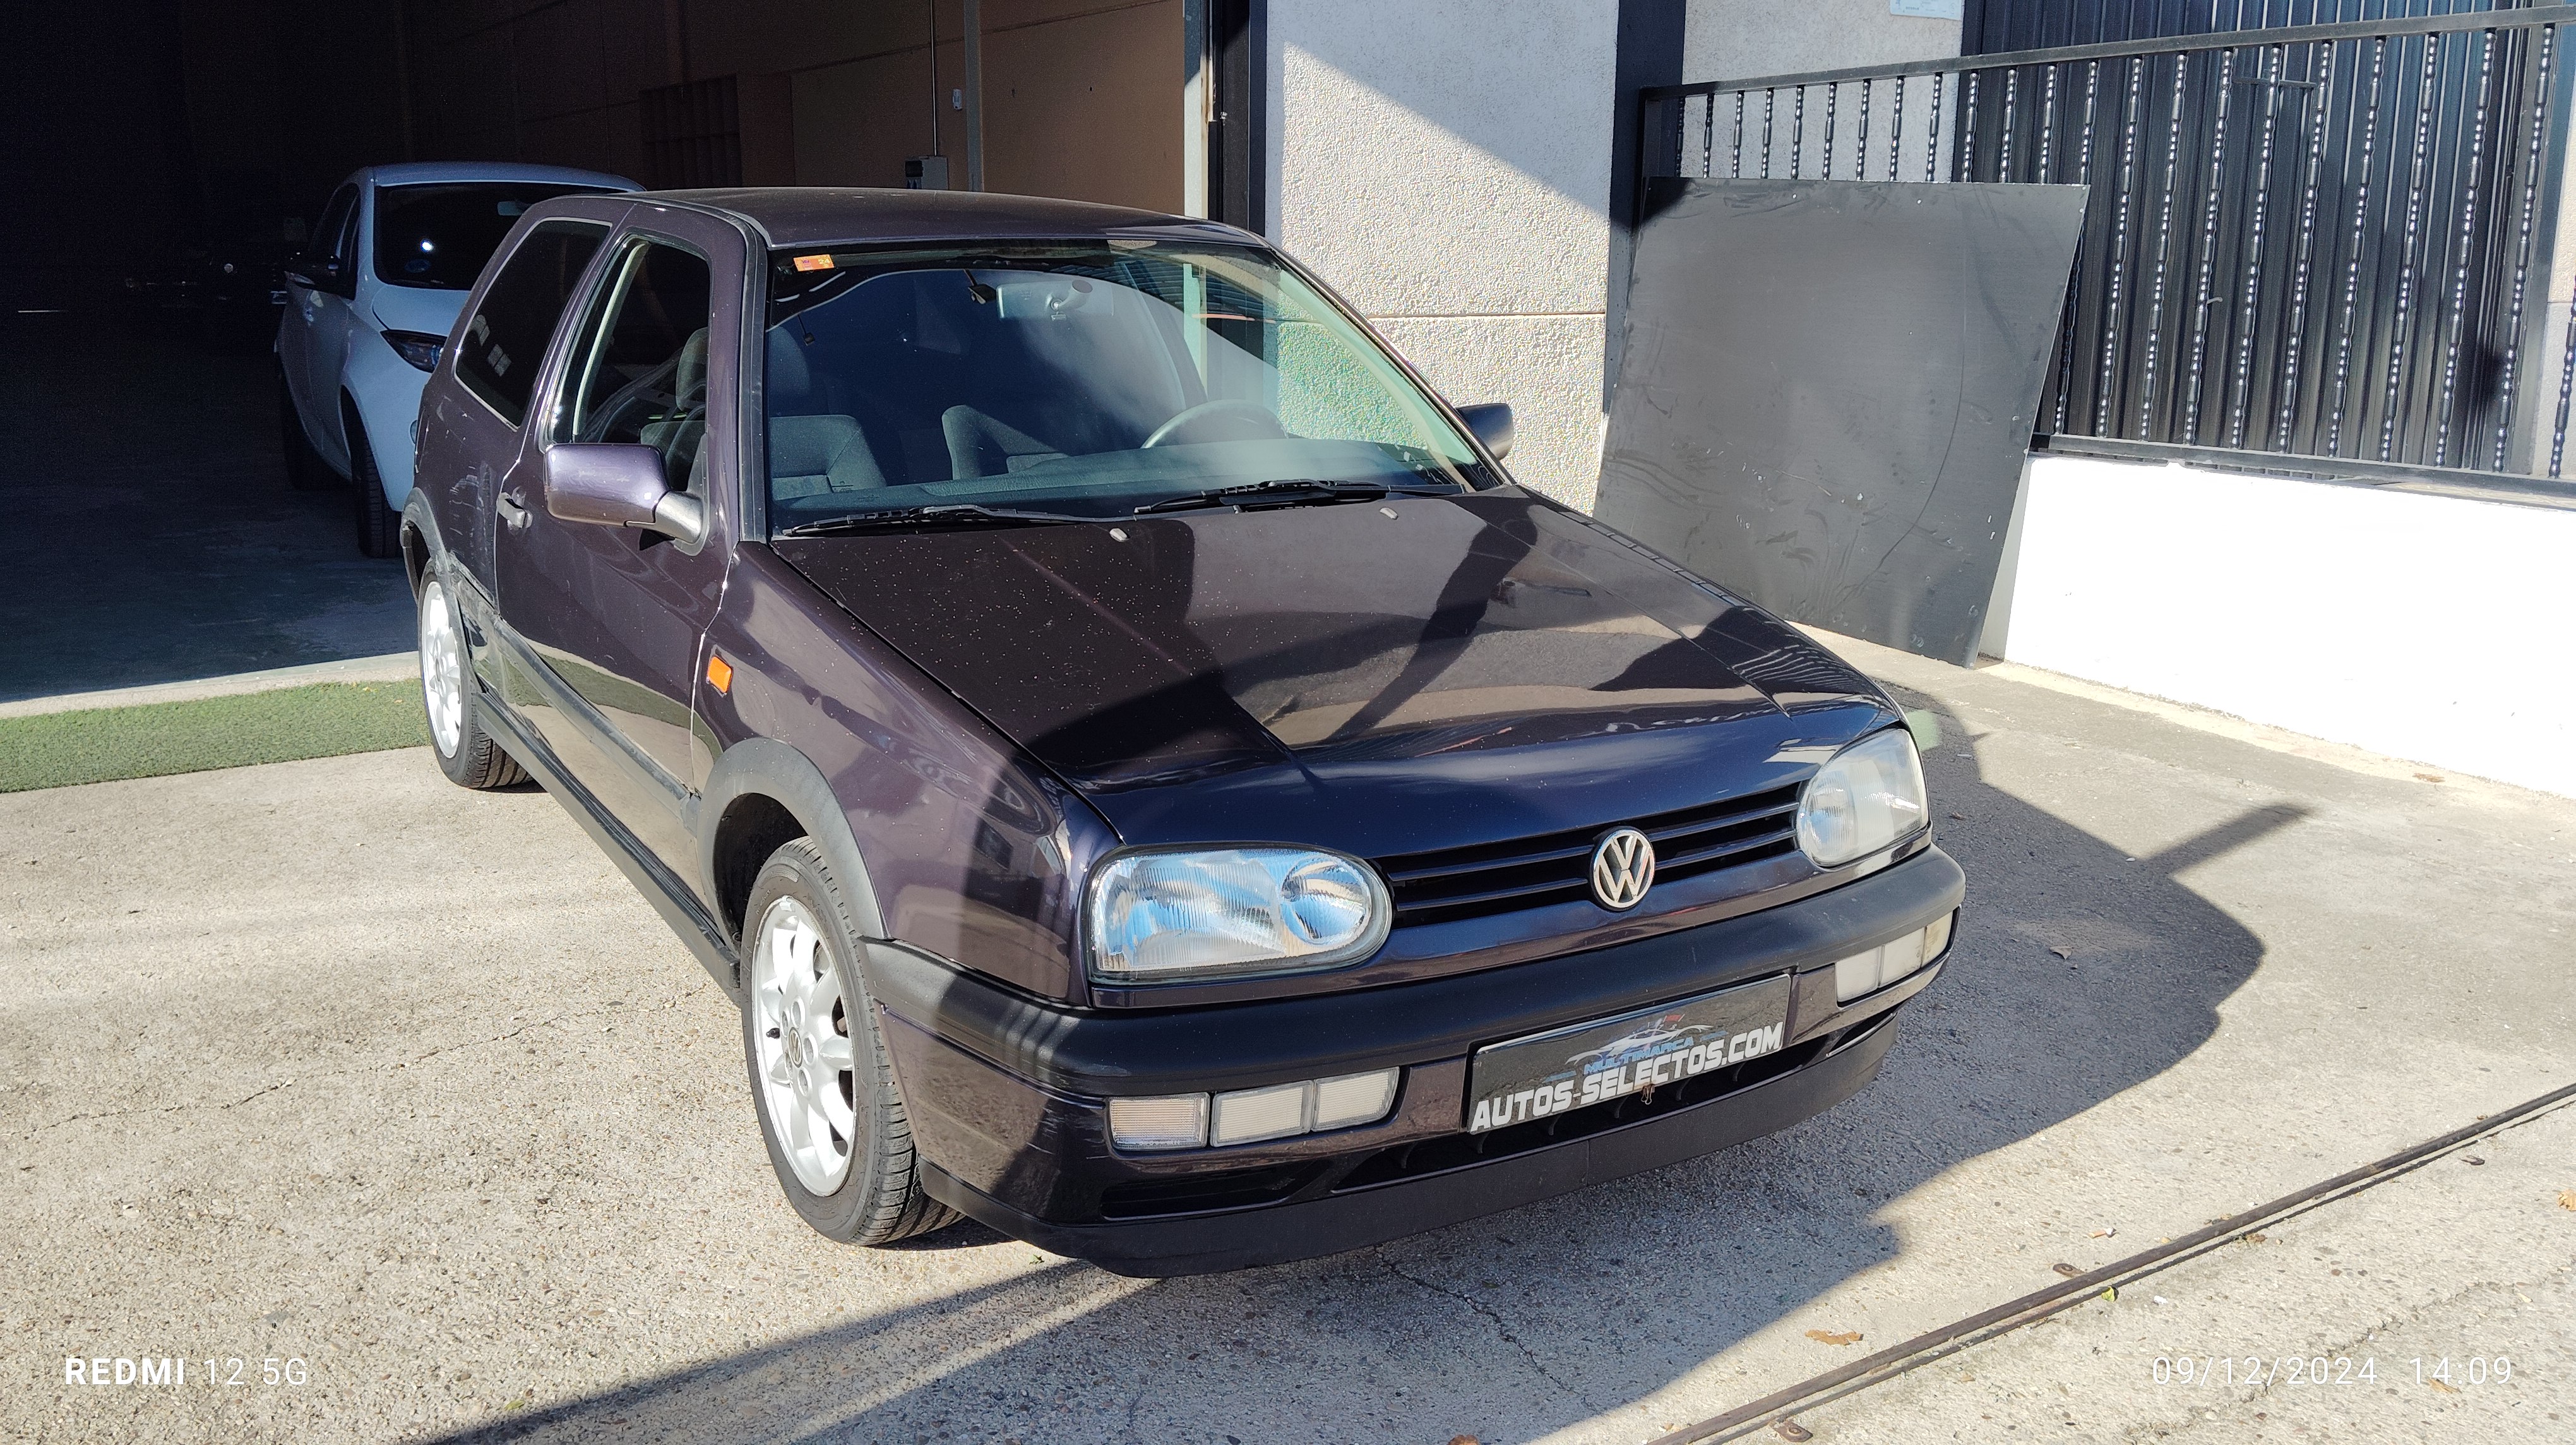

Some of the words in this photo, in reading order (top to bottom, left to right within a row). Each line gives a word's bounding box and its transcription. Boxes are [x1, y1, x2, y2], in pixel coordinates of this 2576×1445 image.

[1594, 829, 1655, 908] VW
[1470, 1022, 1784, 1132] AUTOS-SELECTOS.COM
[1583, 1036, 1695, 1074] MULTIMARCA
